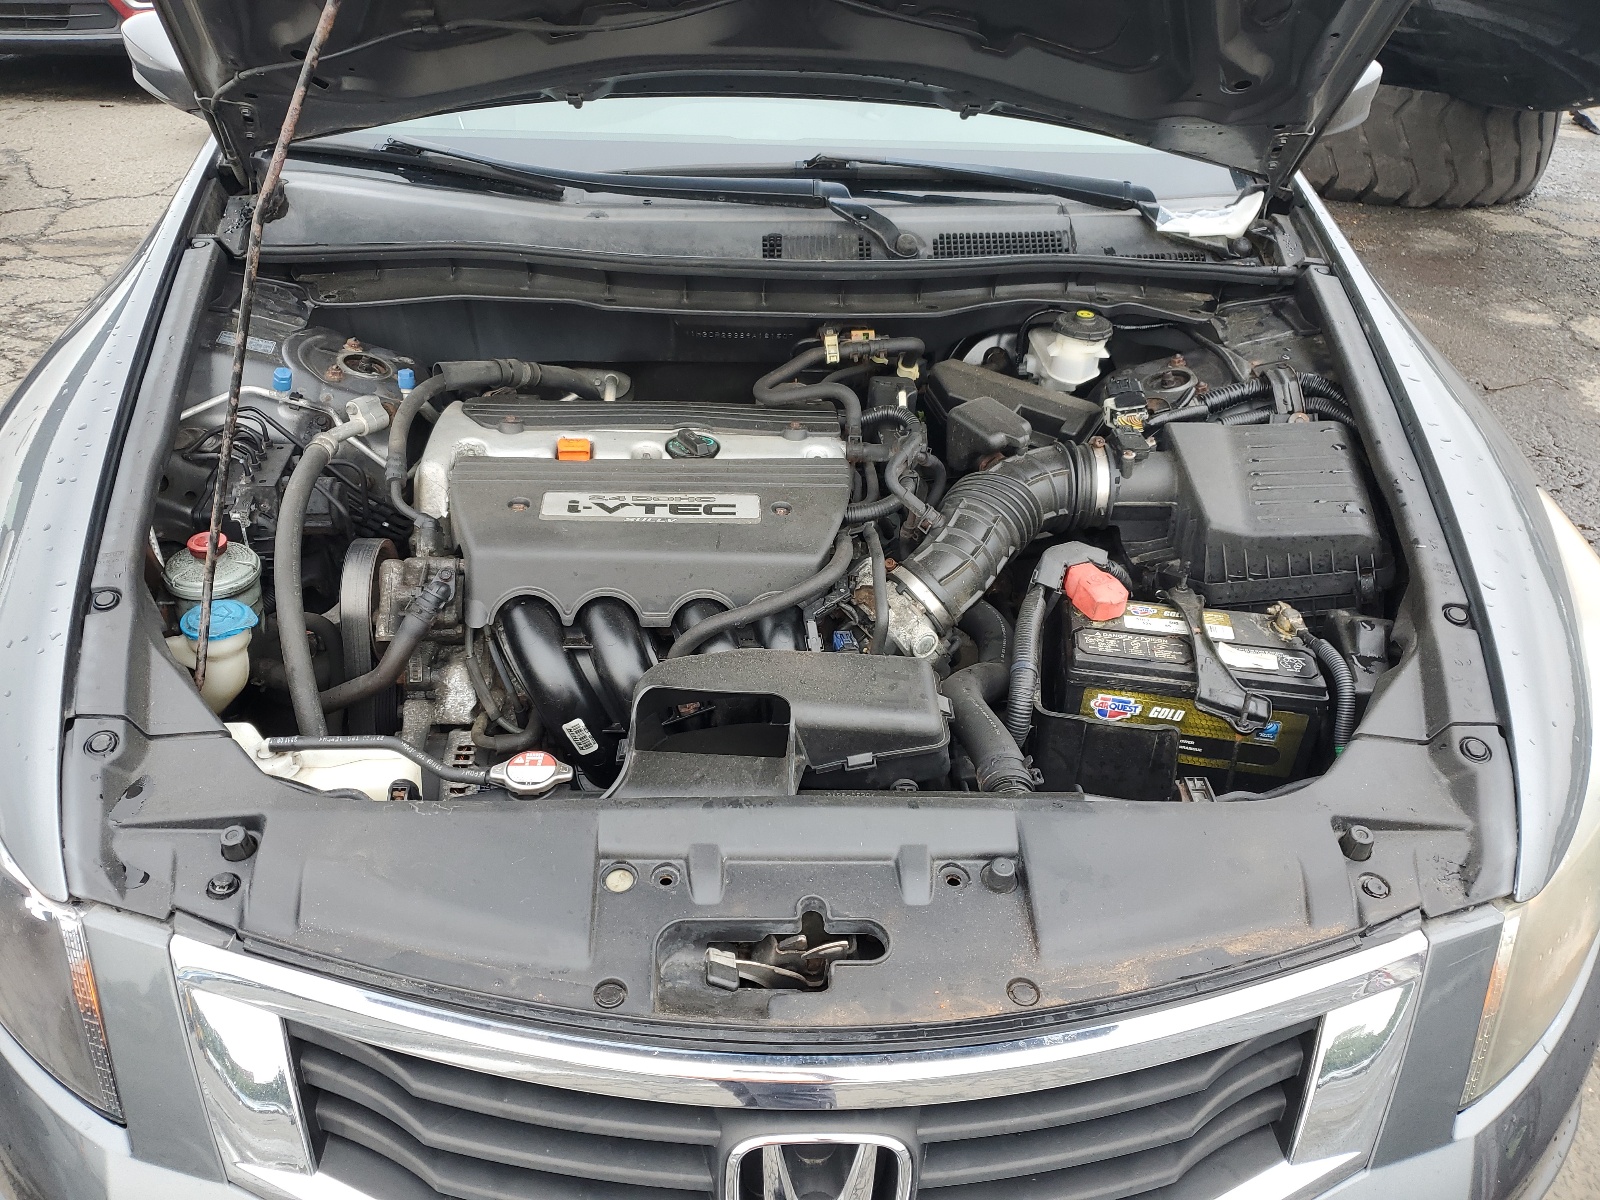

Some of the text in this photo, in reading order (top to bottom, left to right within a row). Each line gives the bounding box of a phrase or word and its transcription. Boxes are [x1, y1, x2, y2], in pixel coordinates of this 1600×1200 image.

[631, 495, 716, 503] DOHC
[567, 499, 737, 516] i-VTEC
[1093, 701, 1139, 713] CARQUEST
[1148, 706, 1185, 722] GOLD
